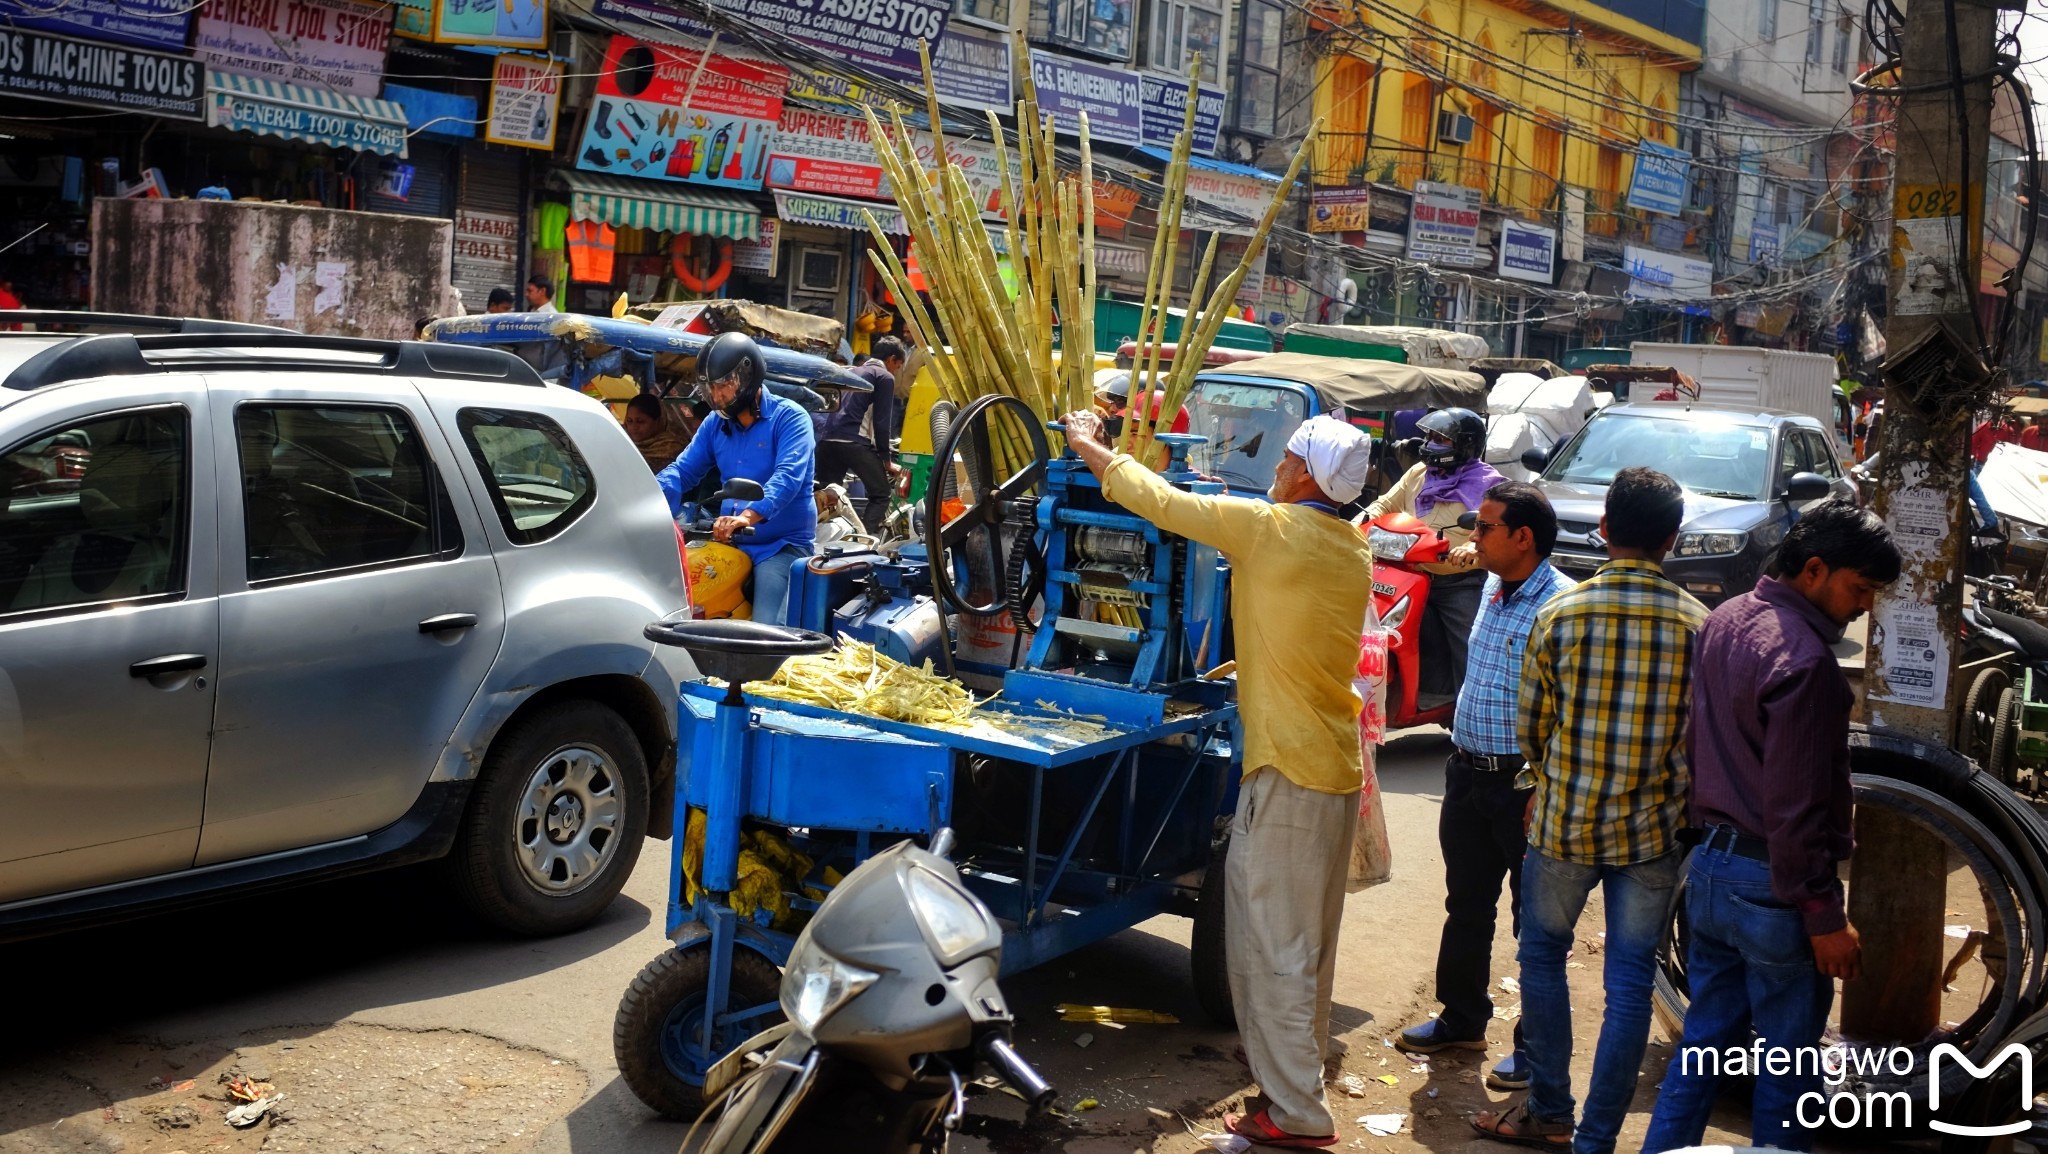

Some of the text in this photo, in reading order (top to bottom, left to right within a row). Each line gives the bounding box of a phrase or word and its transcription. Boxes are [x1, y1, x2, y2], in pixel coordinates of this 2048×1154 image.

[201, 0, 280, 32] GENERAL
[285, 3, 326, 41] TOOL
[334, 14, 392, 51] STORE
[749, 1, 802, 24] ASBESTOS
[802, 14, 812, 26] &
[855, 25, 901, 46] JOINTING
[820, 0, 943, 39] ASBESTOS
[859, 39, 893, 57] PRODUCTS
[33, 38, 127, 87] MACHINE
[133, 55, 195, 97] TOOLS
[497, 63, 558, 94] ANAND TOOLS
[700, 71, 739, 91] SAFETY
[740, 77, 787, 99] TRADERS
[1034, 63, 1056, 92] G.S.
[1056, 68, 1122, 104] ENGINEERING
[1123, 82, 1140, 108] CO.
[232, 101, 401, 147] GENERAL TOOL STORE
[777, 109, 846, 140] SUPREME
[1187, 174, 1262, 200] PREM STORE
[1637, 173, 1682, 196] INTERNATIONAL
[787, 198, 841, 222] SUPREME
[1907, 190, 1957, 213] 082
[457, 214, 515, 237] ANAND
[456, 239, 513, 262] TOOLS
